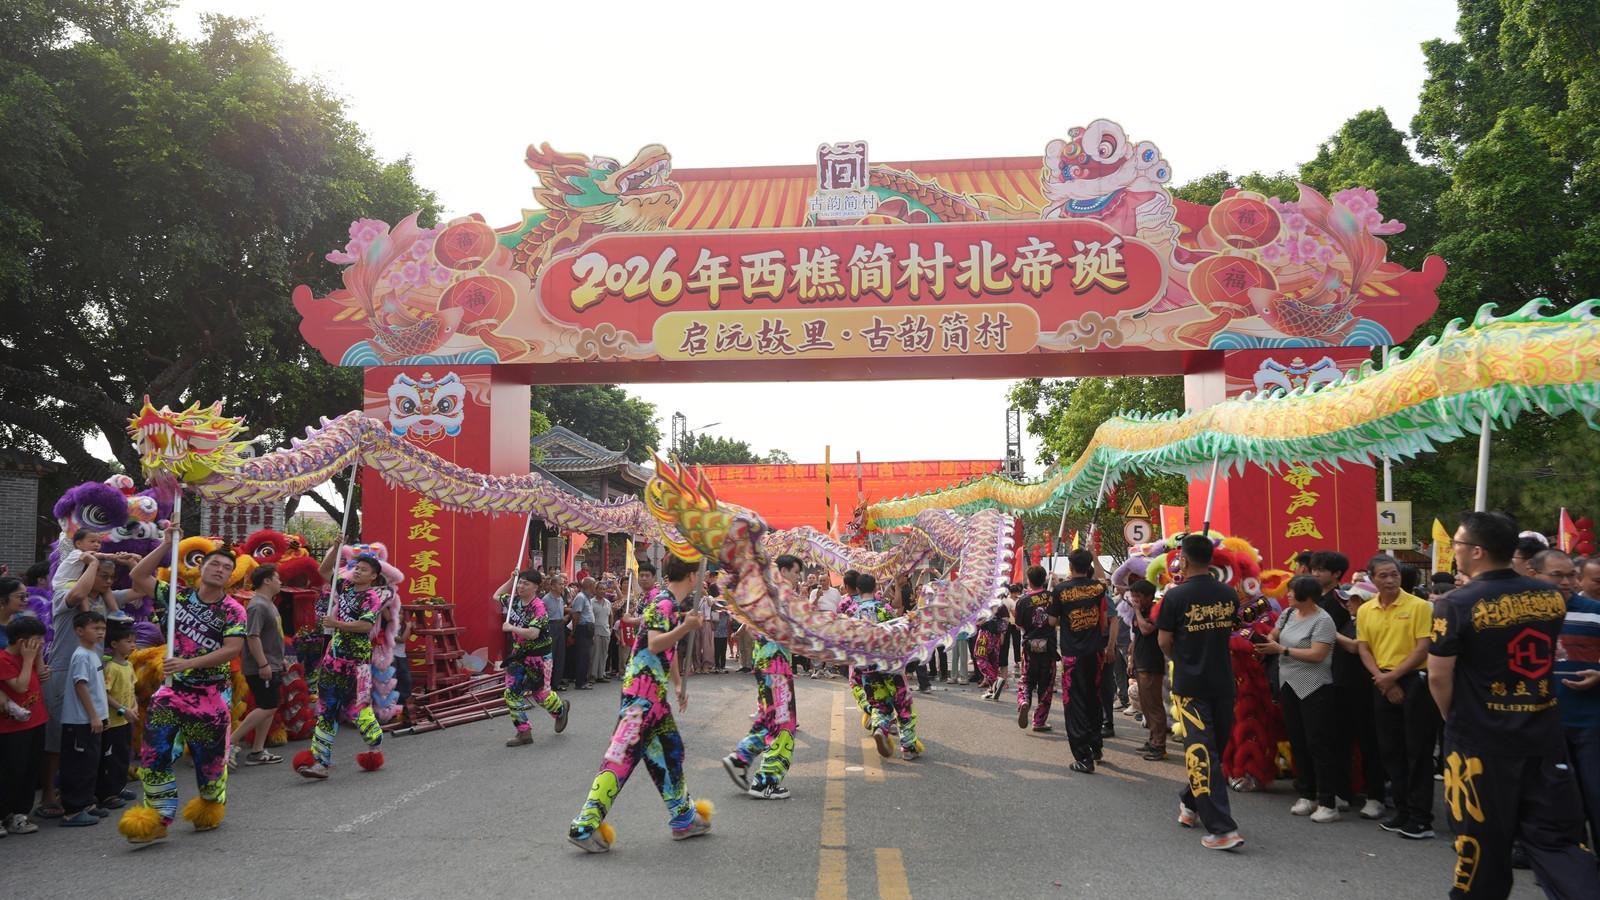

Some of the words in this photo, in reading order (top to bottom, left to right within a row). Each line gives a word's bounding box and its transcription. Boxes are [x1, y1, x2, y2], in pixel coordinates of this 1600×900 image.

[810, 194, 876, 211] 古韵简村
[570, 237, 1130, 310] 2026年西樵简村北帝诞
[1223, 267, 1247, 289] 福
[680, 312, 1012, 357] 启沅故里·古韵简村
[1283, 464, 1324, 571] 帝声威
[1133, 525, 1144, 541] 5
[1377, 537, 1407, 545] 止左转
[175, 603, 209, 632] PORTS
